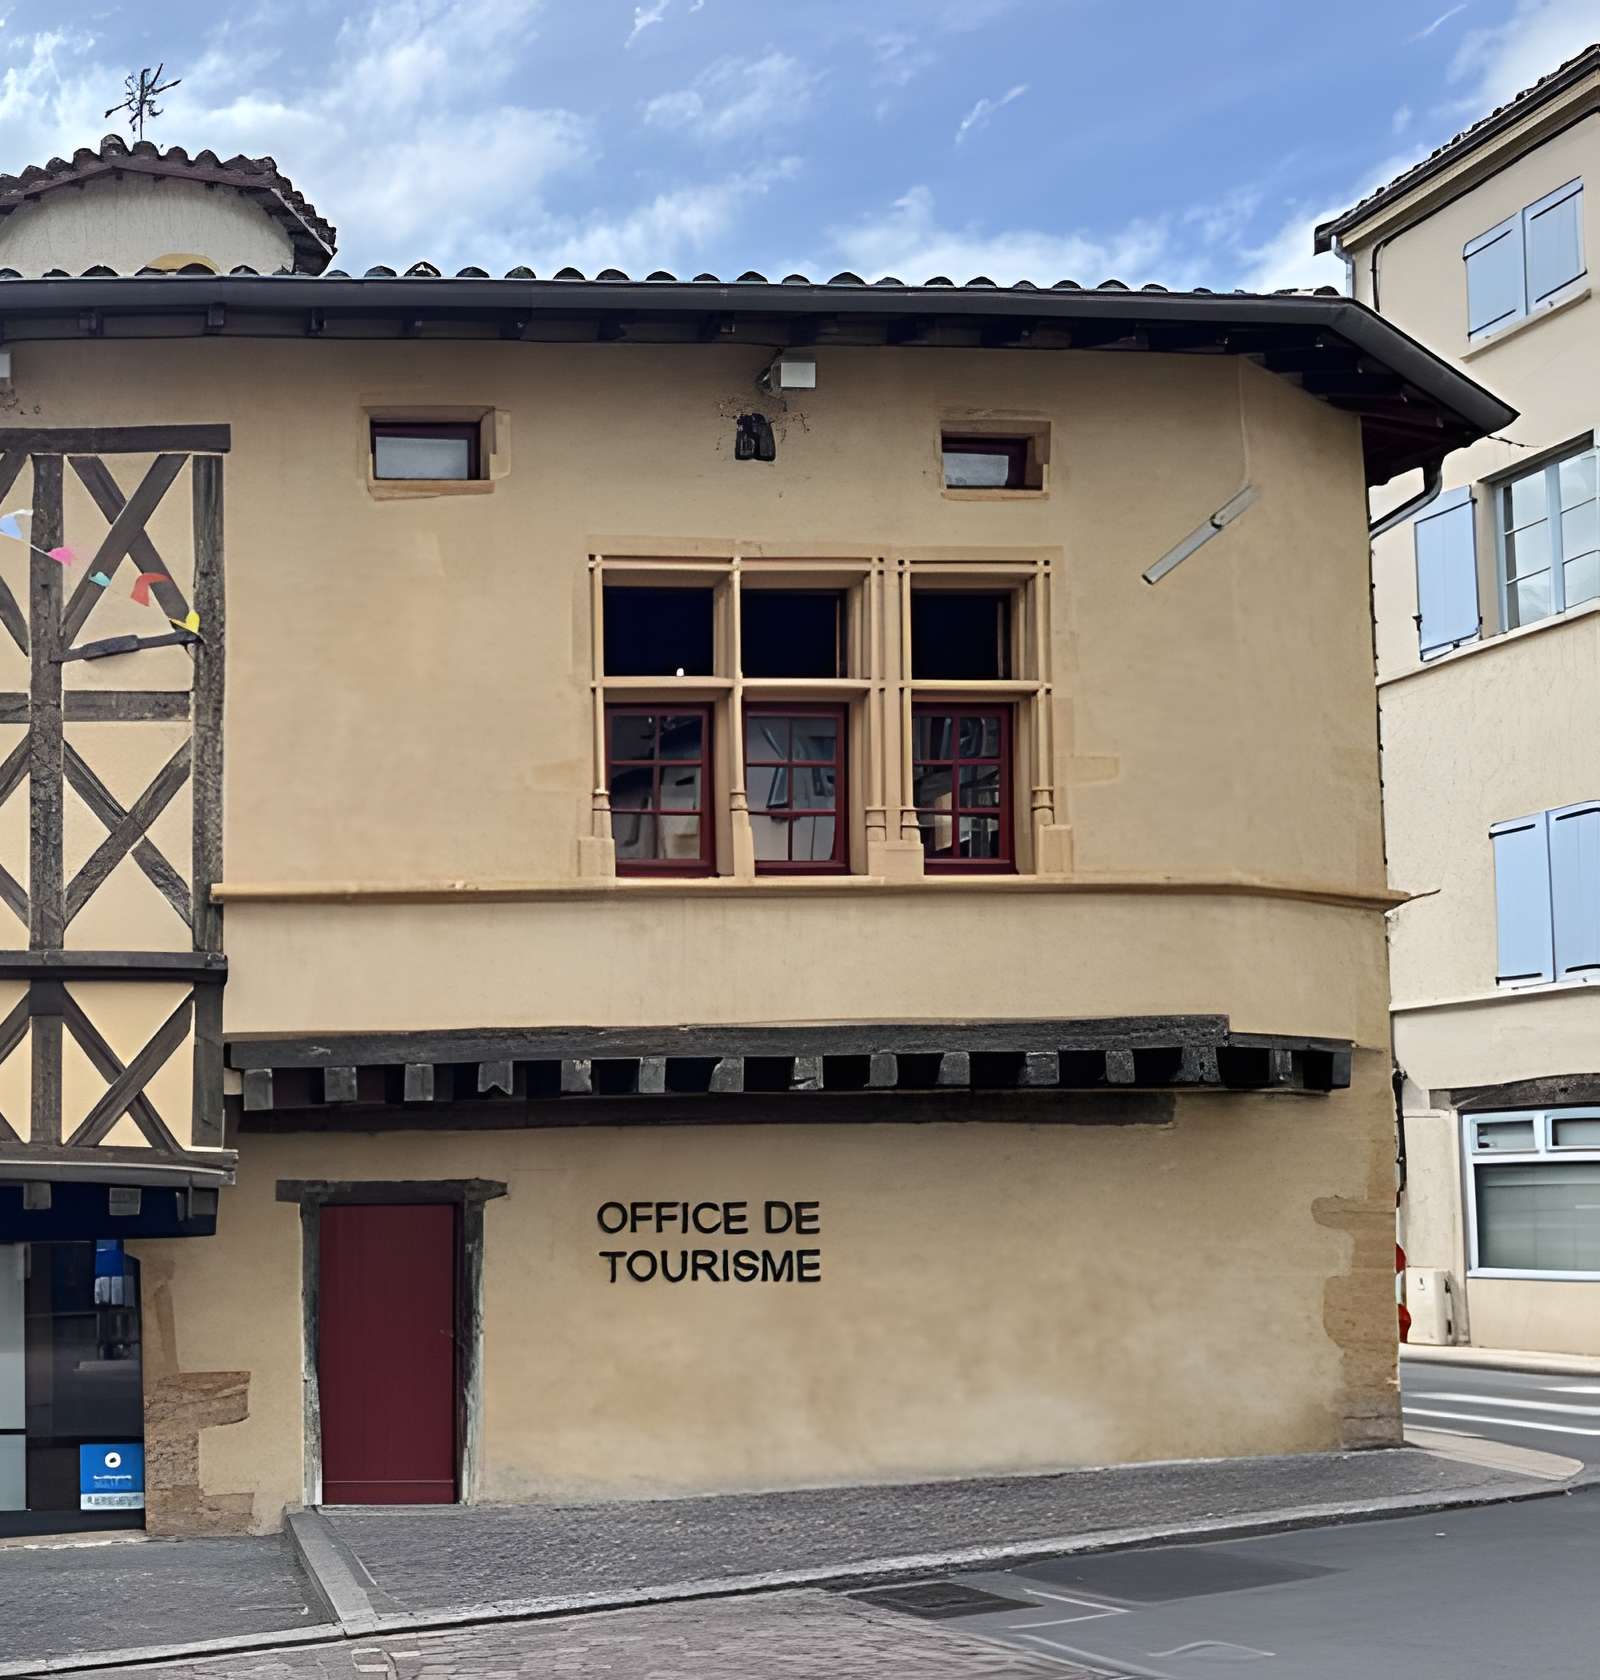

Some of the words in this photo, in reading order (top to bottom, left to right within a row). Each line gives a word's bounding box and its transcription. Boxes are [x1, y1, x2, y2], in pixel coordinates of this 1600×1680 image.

[596, 1201, 749, 1235] OFFICE
[764, 1200, 821, 1235] DE
[598, 1248, 821, 1284] TOURISME
